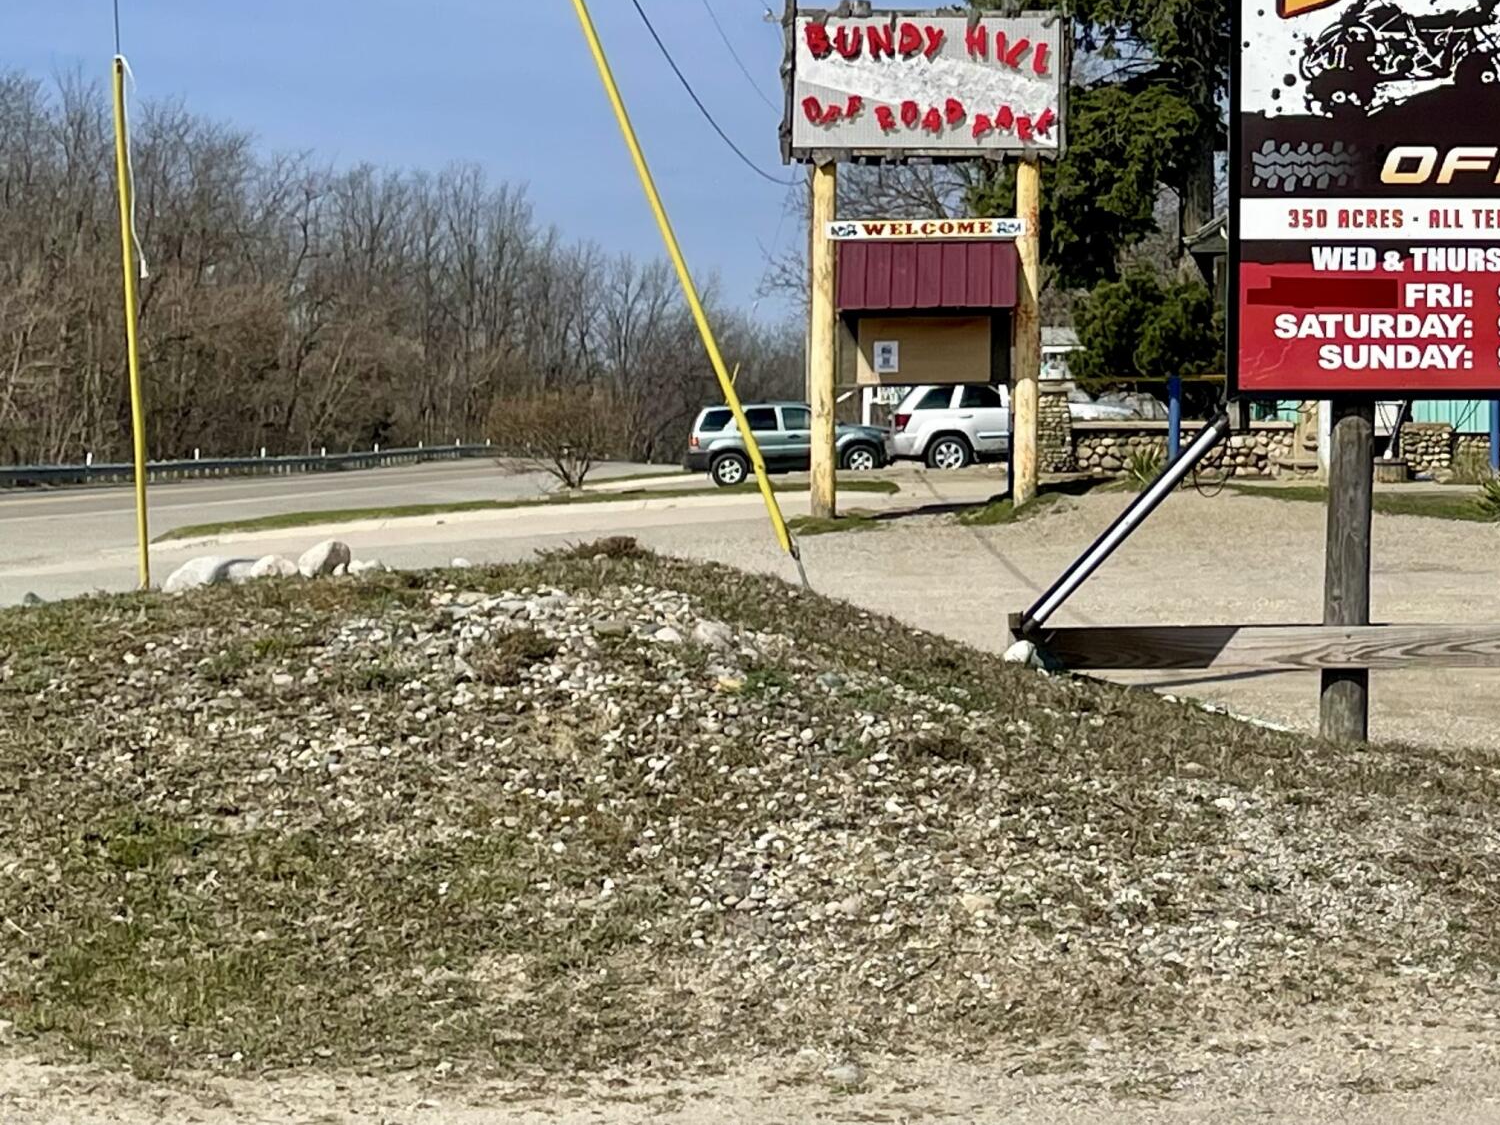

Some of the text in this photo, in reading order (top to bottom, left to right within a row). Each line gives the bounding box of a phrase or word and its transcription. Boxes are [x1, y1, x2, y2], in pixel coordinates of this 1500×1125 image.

[804, 21, 1048, 75] BUNDY HILL
[875, 97, 966, 133] ROAD
[972, 105, 1055, 140] PARK
[861, 221, 993, 236] WELCOME
[1288, 208, 1328, 229] 350
[1337, 208, 1404, 229] ACRES
[1428, 209, 1464, 229] ALL
[1311, 247, 1377, 271] WED
[1382, 251, 1404, 272] &
[1405, 283, 1473, 308] FRI:
[1274, 313, 1473, 338] SATURDAY:
[1318, 344, 1473, 369] SUNDAY:
